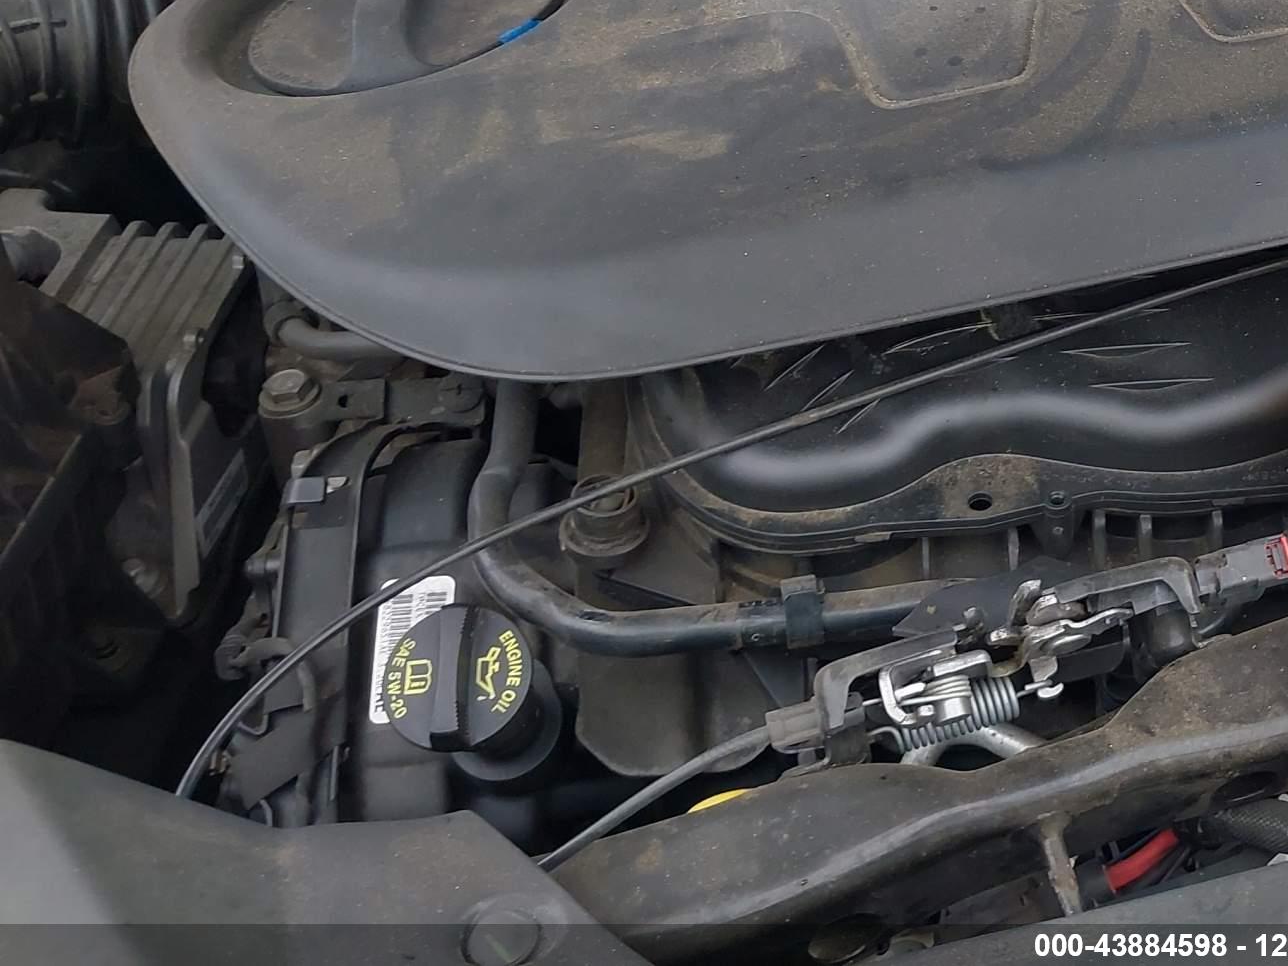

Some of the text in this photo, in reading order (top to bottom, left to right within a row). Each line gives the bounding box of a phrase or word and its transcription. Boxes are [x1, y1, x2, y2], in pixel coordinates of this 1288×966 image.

[387, 637, 416, 719] SAE 5W-20
[491, 630, 523, 714] ENGINE OIL
